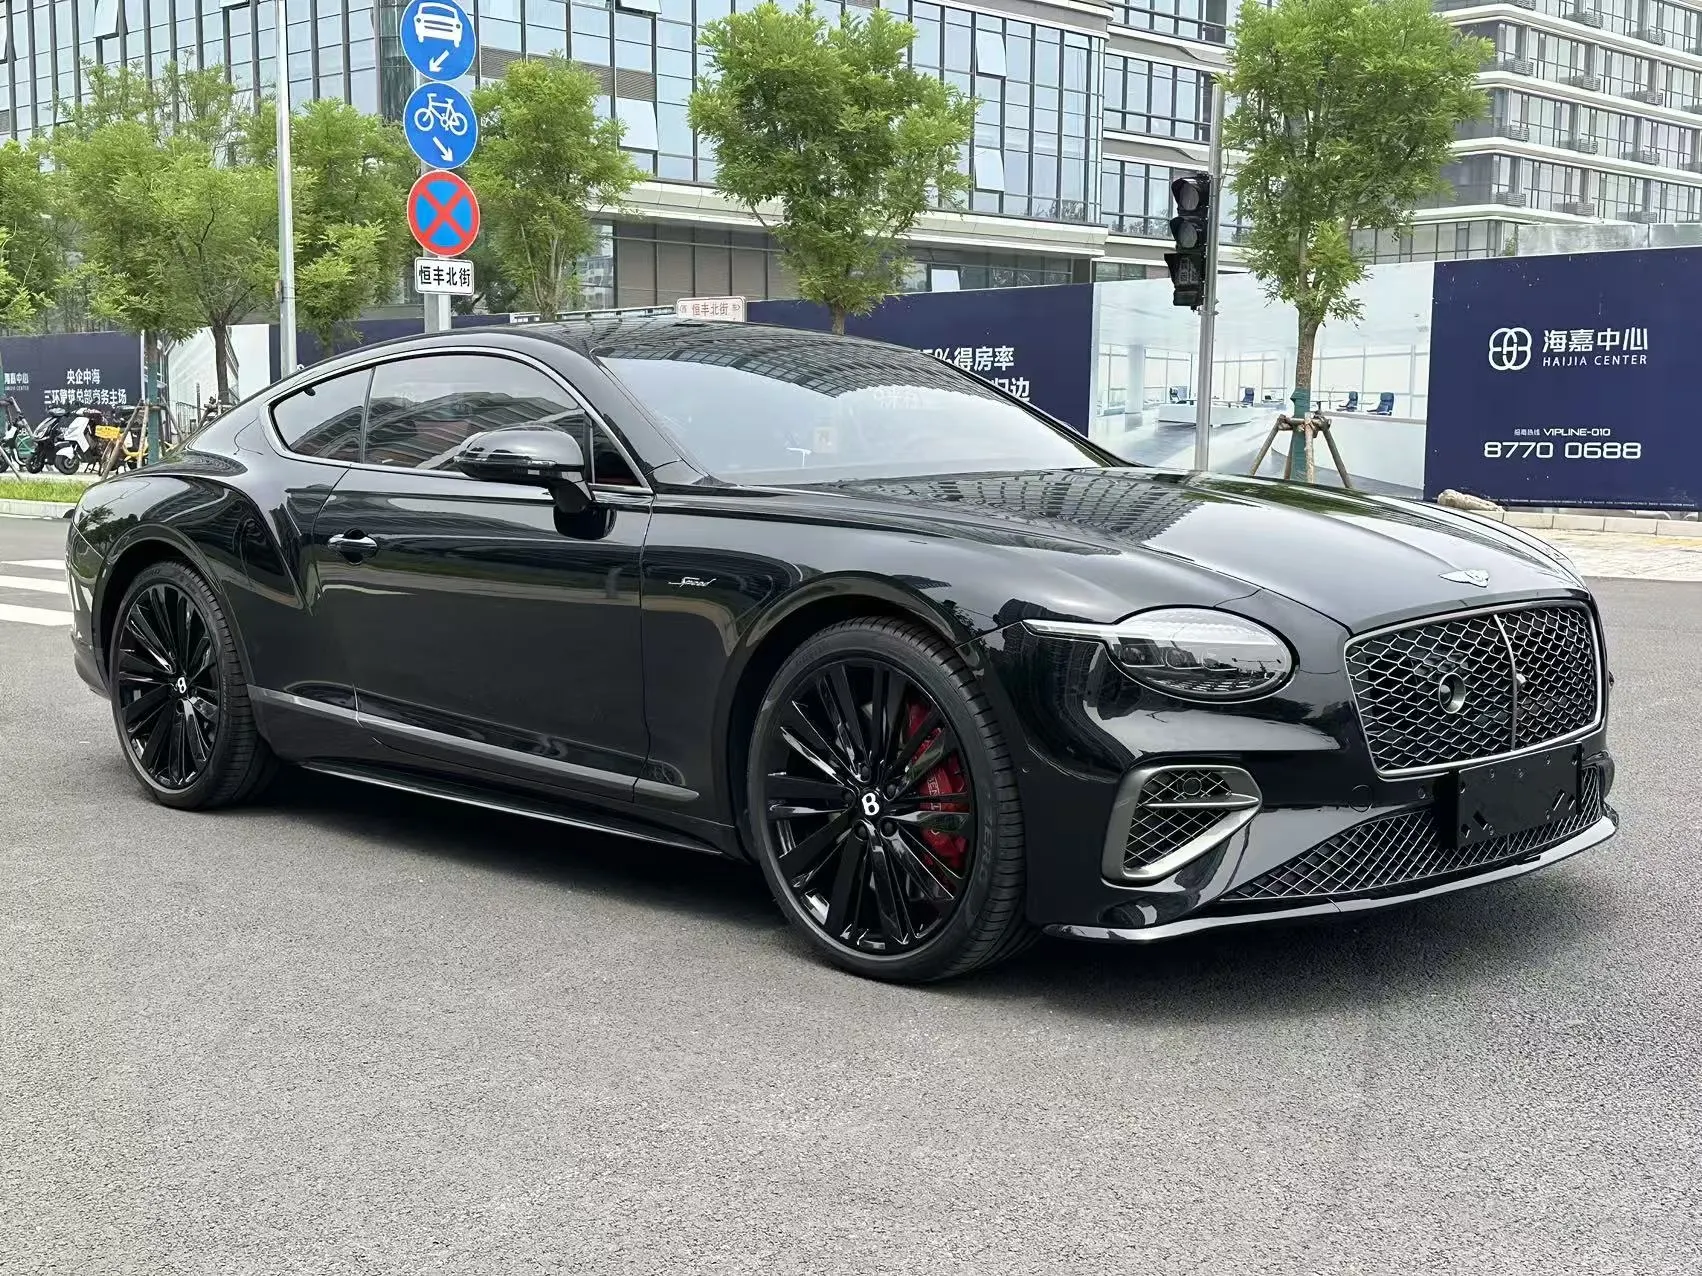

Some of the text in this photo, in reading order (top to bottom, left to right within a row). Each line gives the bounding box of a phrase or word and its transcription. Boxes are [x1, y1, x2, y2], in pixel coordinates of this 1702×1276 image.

[419, 265, 471, 287] 恒丰北街
[692, 302, 729, 316] 恒丰北街
[1542, 327, 1649, 353] 海嘉中心
[1542, 355, 1648, 367] HAIJIA CENTER
[66, 368, 101, 385] 央企中海
[1543, 428, 1611, 437] VIPLINE-010
[1484, 441, 1642, 459] 8770 0688
[861, 792, 880, 816] B
